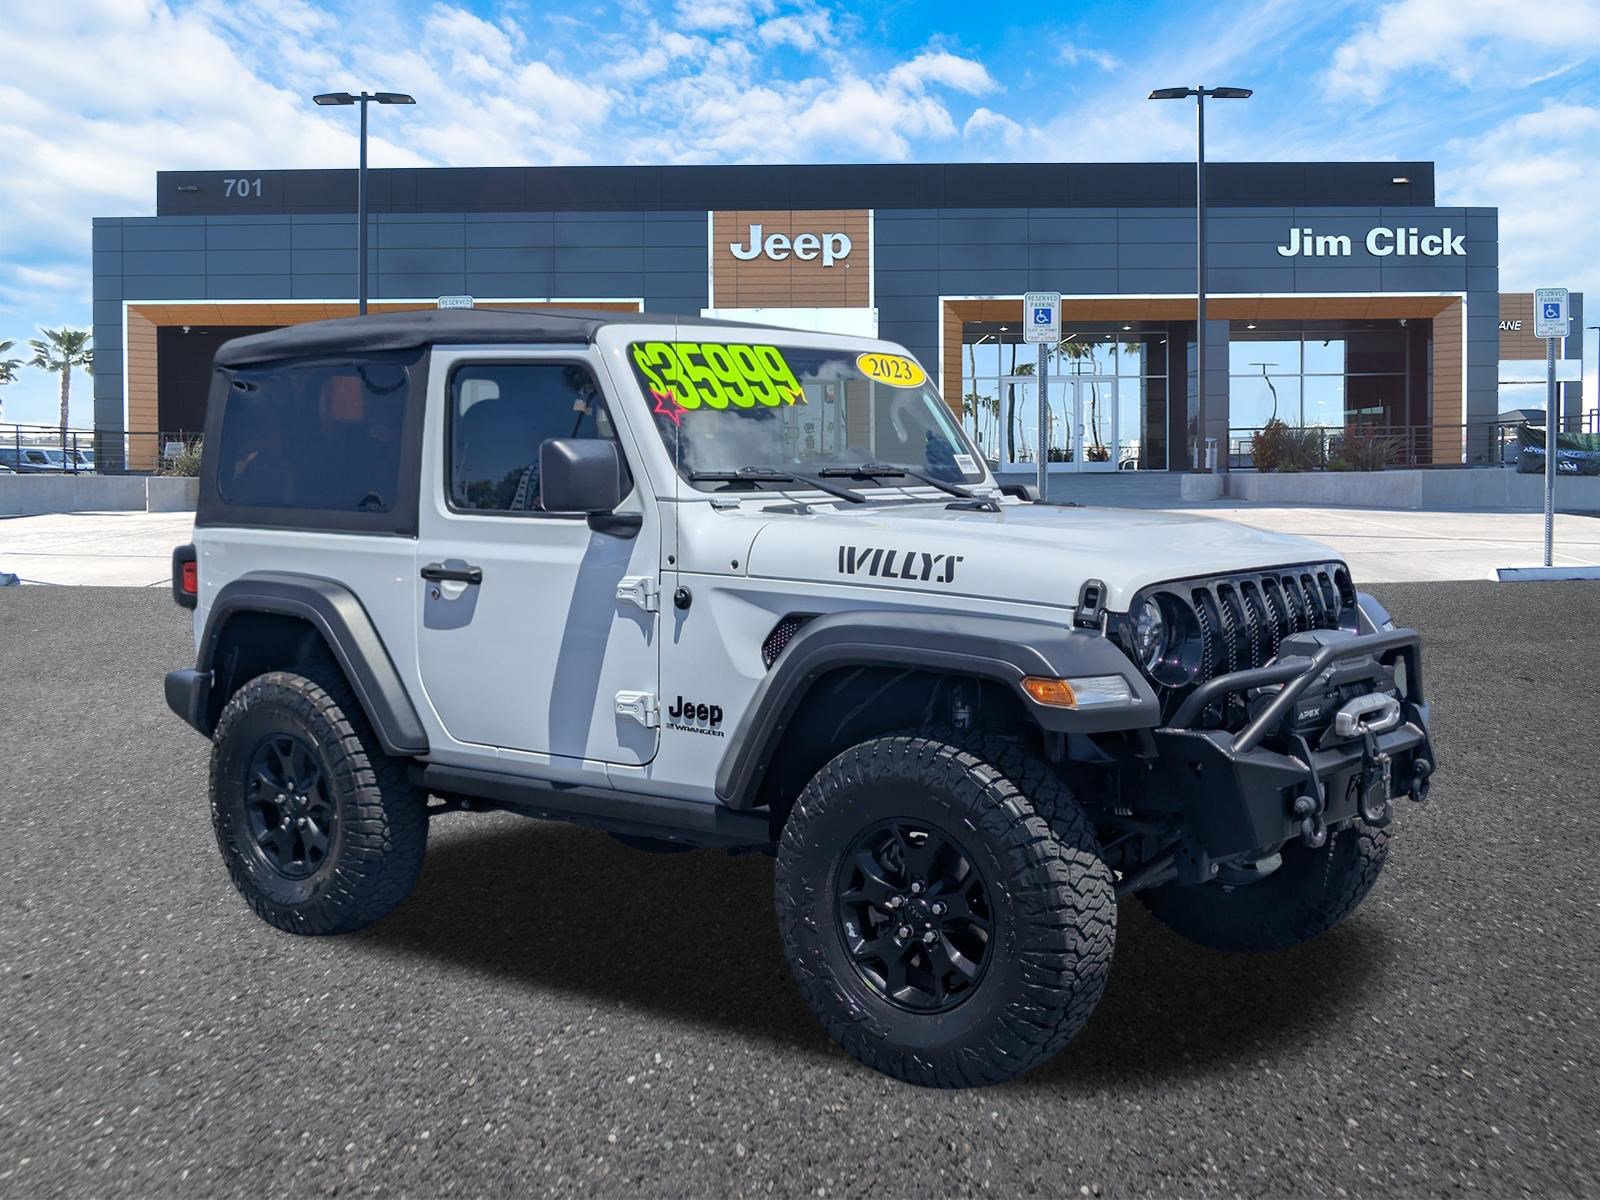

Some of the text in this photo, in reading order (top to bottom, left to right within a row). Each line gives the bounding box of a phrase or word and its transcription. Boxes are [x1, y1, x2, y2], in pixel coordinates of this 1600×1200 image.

[223, 178, 262, 197] 701
[729, 224, 852, 267] Jeep
[1277, 227, 1467, 257] Jim Click
[633, 343, 804, 409] $35999
[869, 358, 912, 380] 2023
[838, 545, 964, 583] WILLYS
[669, 696, 723, 726] Jeep
[1298, 708, 1320, 720] APEX
[675, 724, 725, 737] WRANGLER
